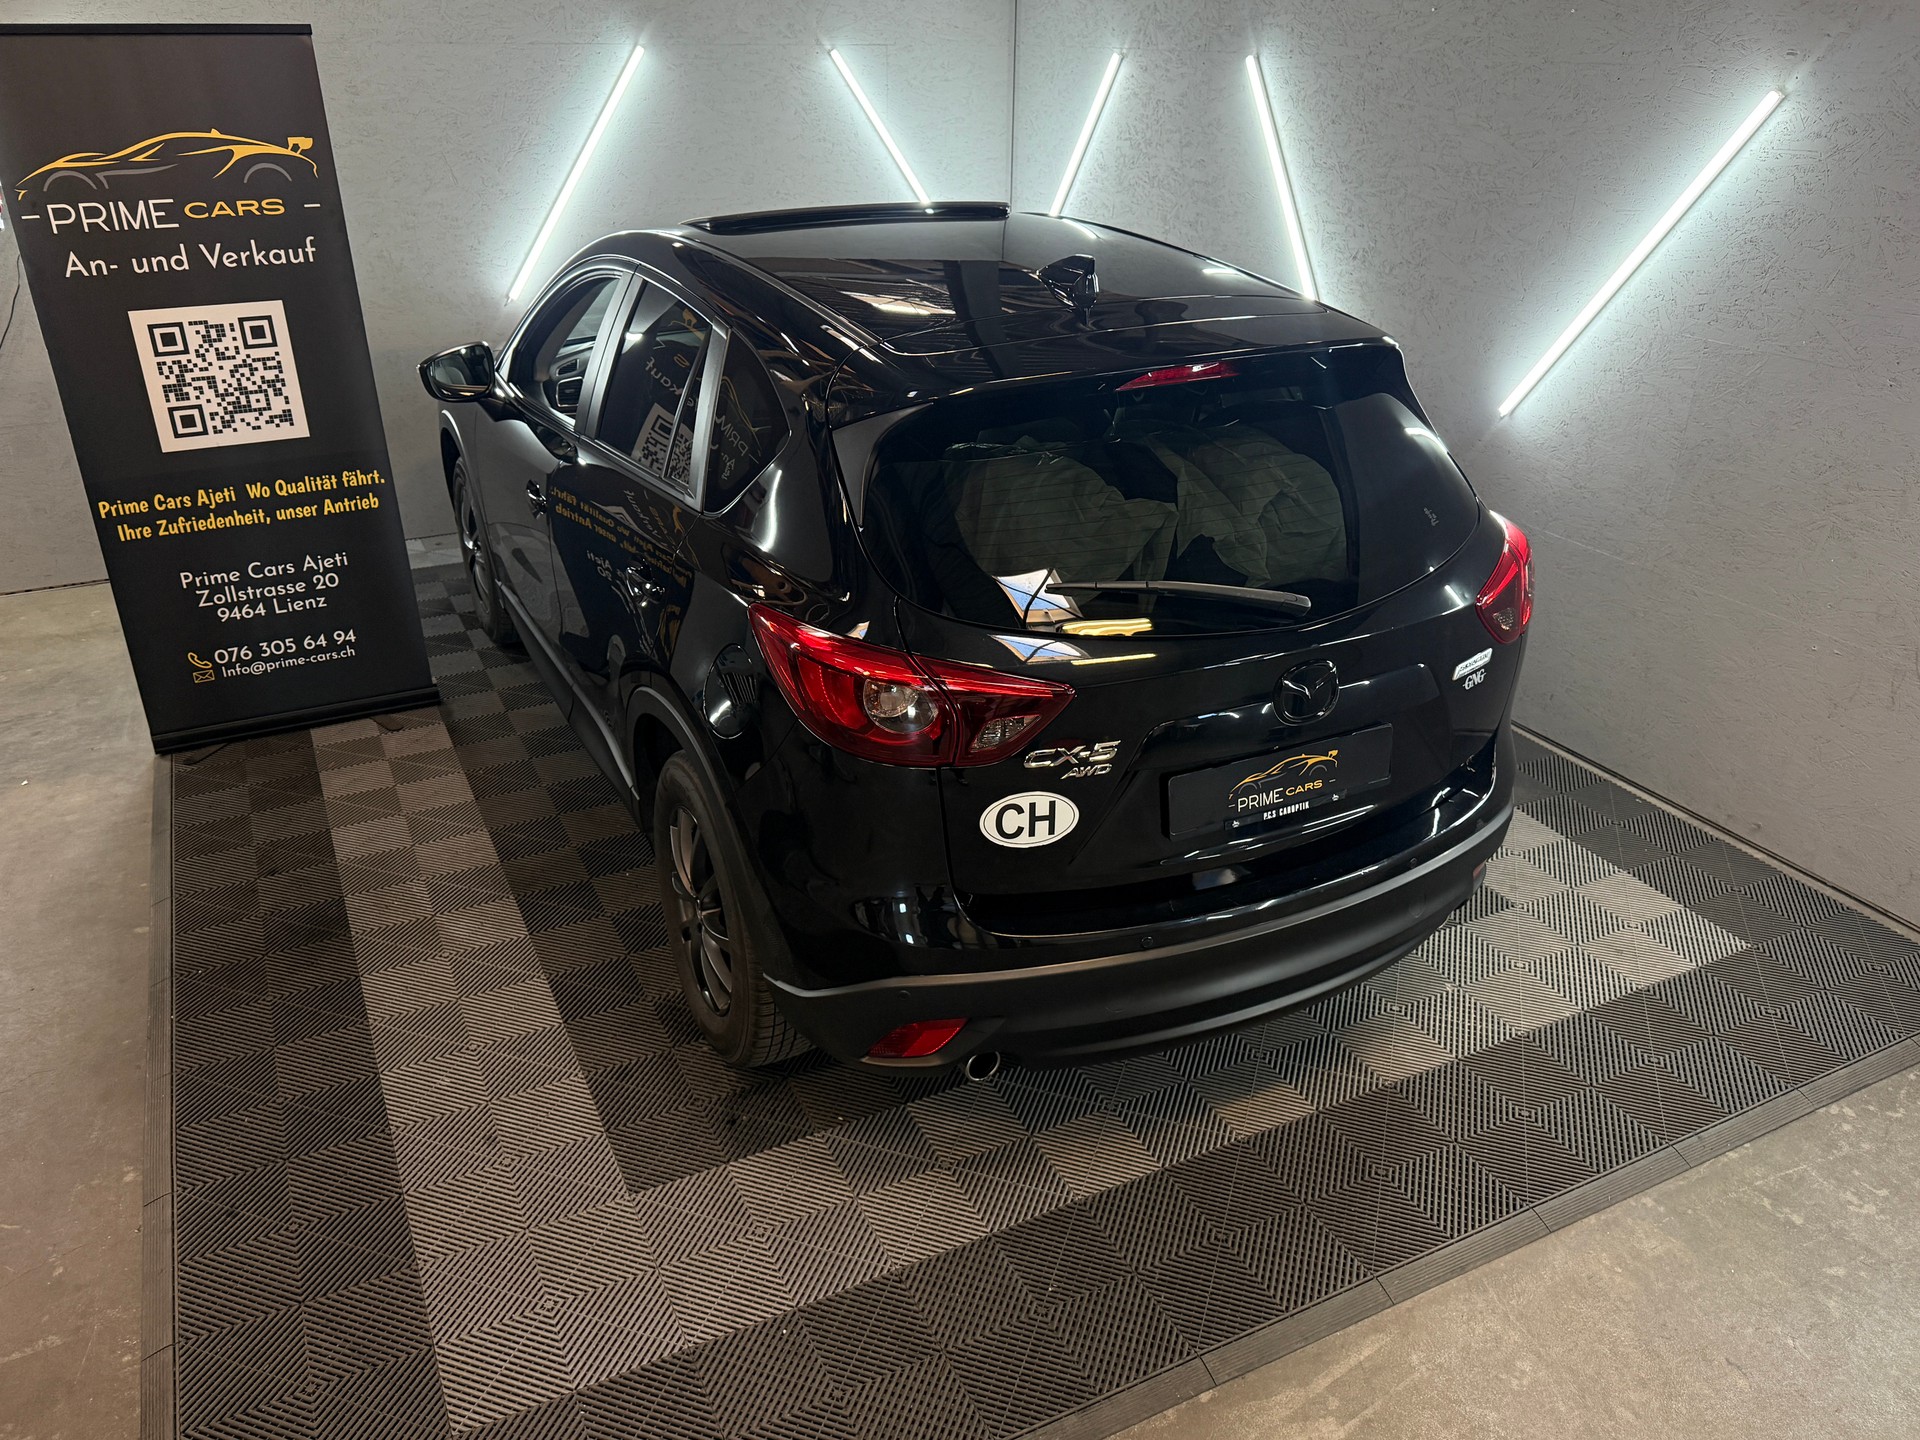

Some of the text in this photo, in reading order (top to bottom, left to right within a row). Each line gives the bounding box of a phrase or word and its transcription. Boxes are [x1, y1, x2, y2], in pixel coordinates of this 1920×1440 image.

[46, 198, 284, 235] PRIME CARS
[66, 236, 315, 277] An- und Verkauf
[99, 470, 384, 518] Prime Cars Ajeti Wo Qualität fährt.
[118, 493, 378, 541] Ihre Zufriedenheit, unser Antrieb
[180, 552, 347, 588] Prime Cars Ajeti
[196, 573, 338, 607] Zollstrasse 20
[218, 598, 327, 622] 9464 Lienz
[215, 629, 356, 663] 076 305 64 94
[222, 645, 355, 677] Info@prime-cars.ch
[1023, 740, 1121, 769] CX-5
[1060, 763, 1112, 780] AWD
[1238, 780, 1323, 812] PRIME CARS
[994, 800, 1057, 840] CH
